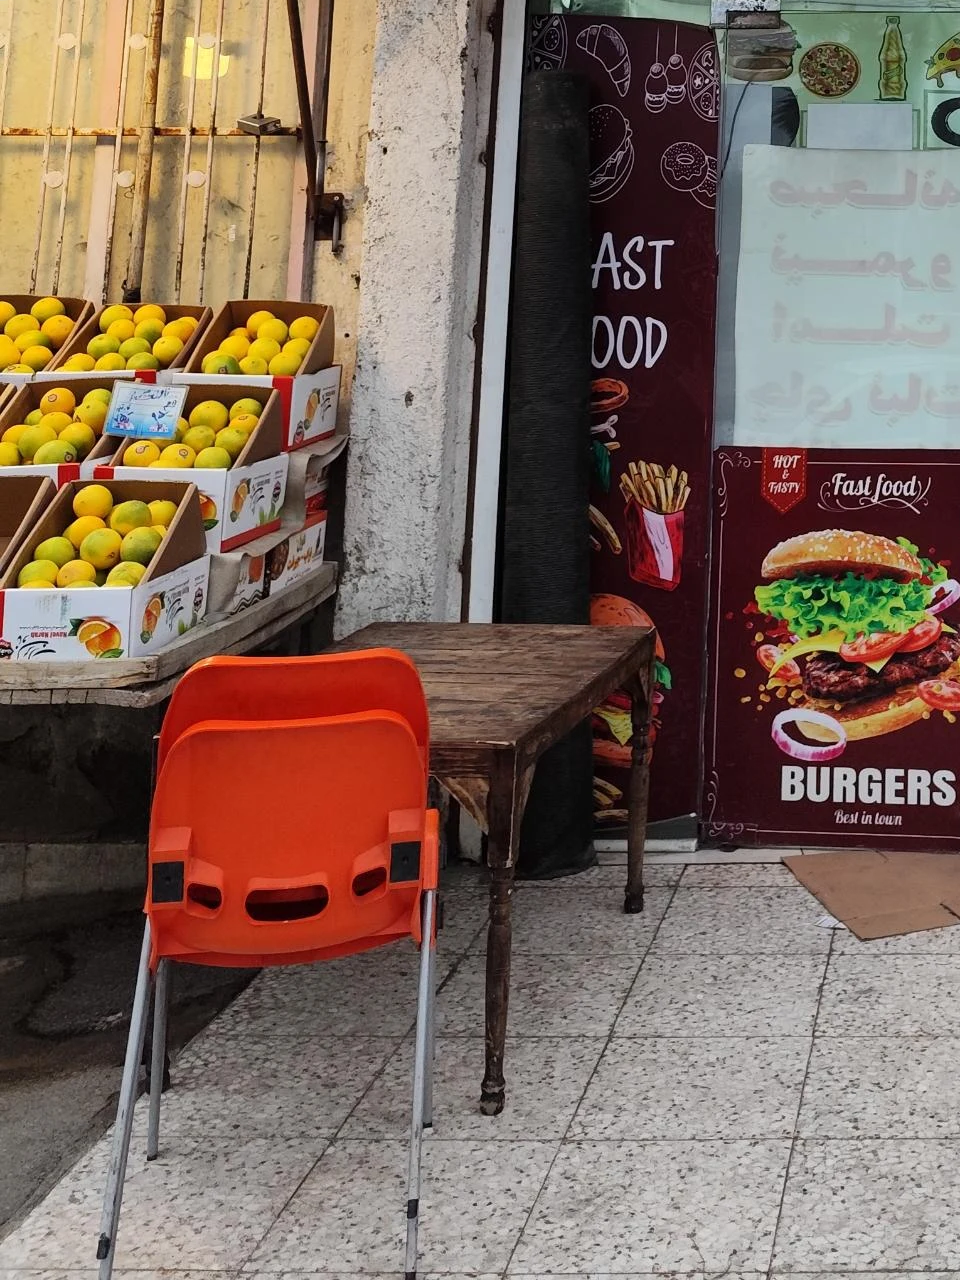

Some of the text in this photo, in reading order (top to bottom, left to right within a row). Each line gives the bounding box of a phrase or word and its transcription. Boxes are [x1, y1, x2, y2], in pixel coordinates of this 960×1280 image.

[591, 231, 676, 290] AST
[591, 315, 668, 370] OOD
[772, 454, 802, 469] HOT
[782, 468, 791, 479] &
[768, 481, 801, 494] TASTY
[831, 472, 918, 503] Fast food
[780, 765, 957, 807] BURGERS
[834, 808, 903, 827] Best in town
